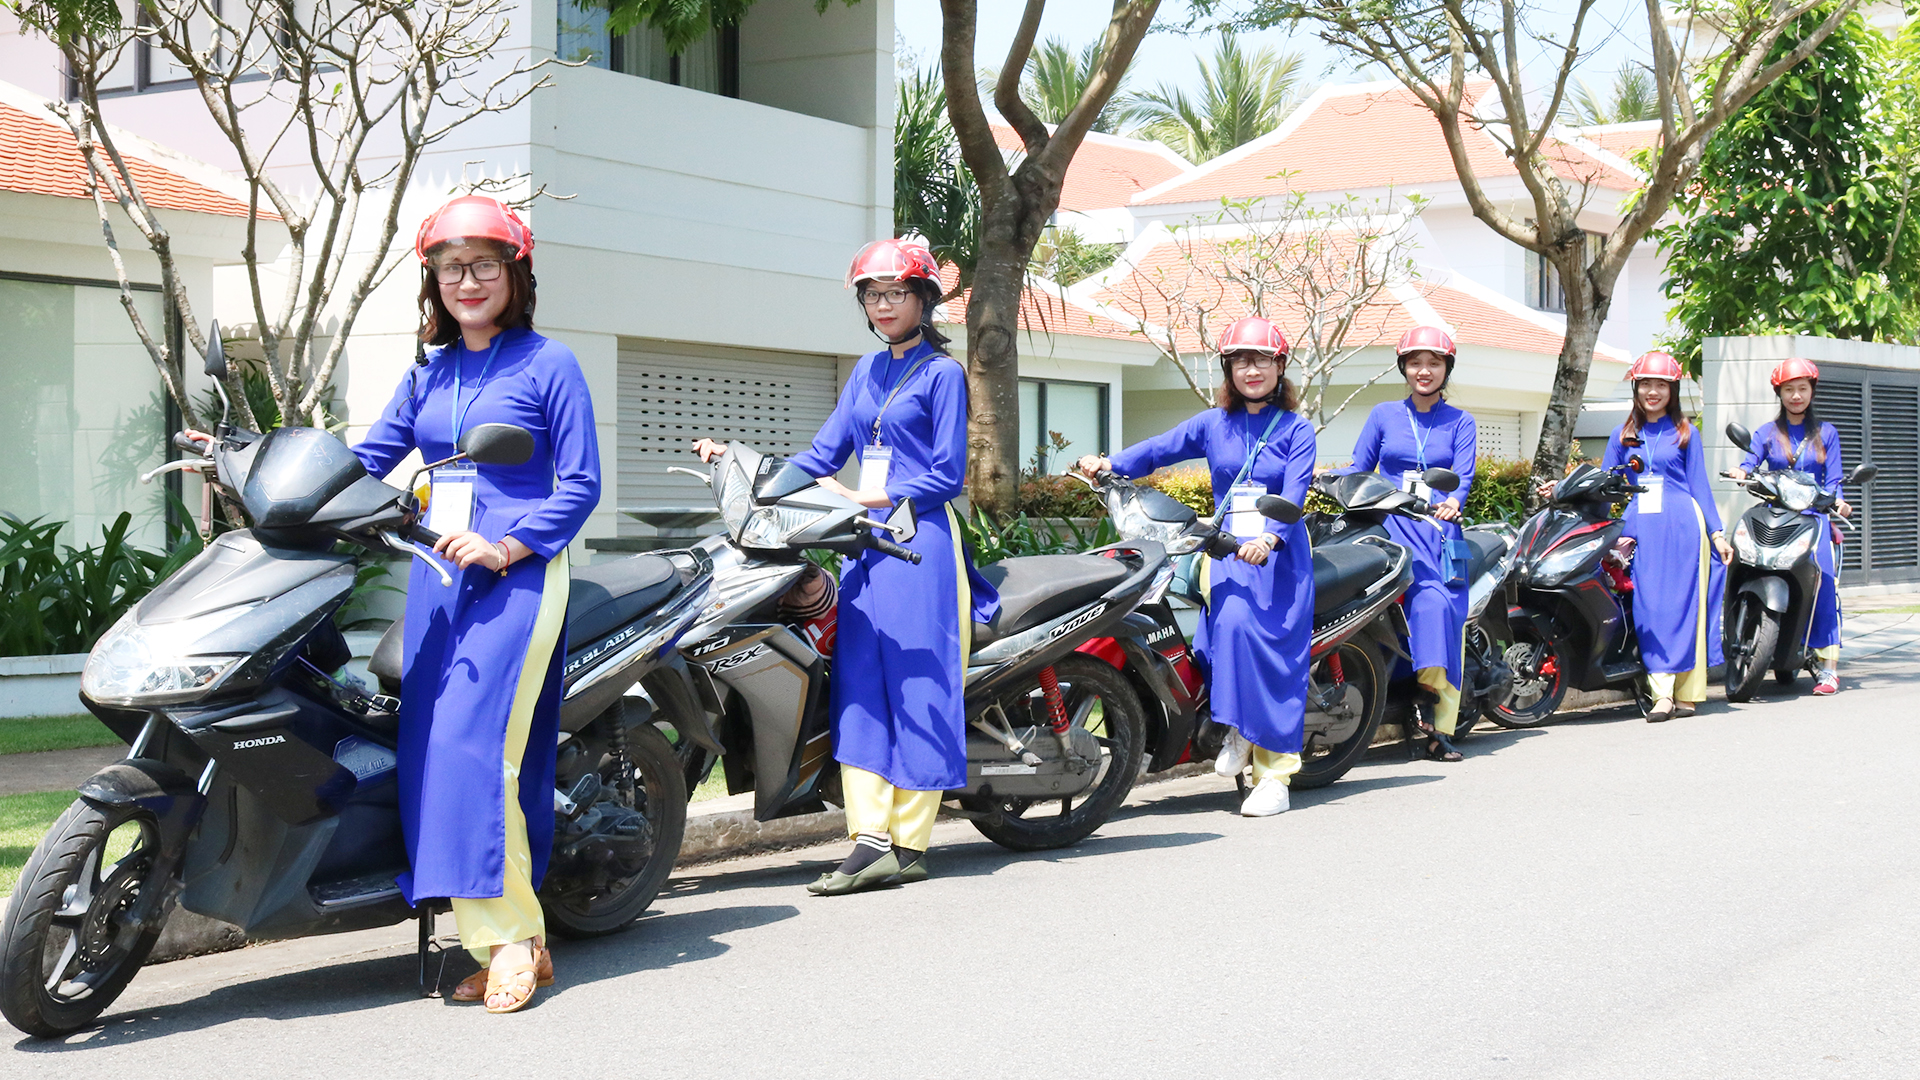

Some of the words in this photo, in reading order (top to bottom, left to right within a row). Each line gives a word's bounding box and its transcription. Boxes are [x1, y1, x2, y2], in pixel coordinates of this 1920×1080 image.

[581, 626, 636, 664] BLADE
[693, 636, 730, 656] 110
[710, 643, 765, 674] RSX
[233, 735, 286, 750] HONDA
[353, 758, 387, 776] RBLADE
